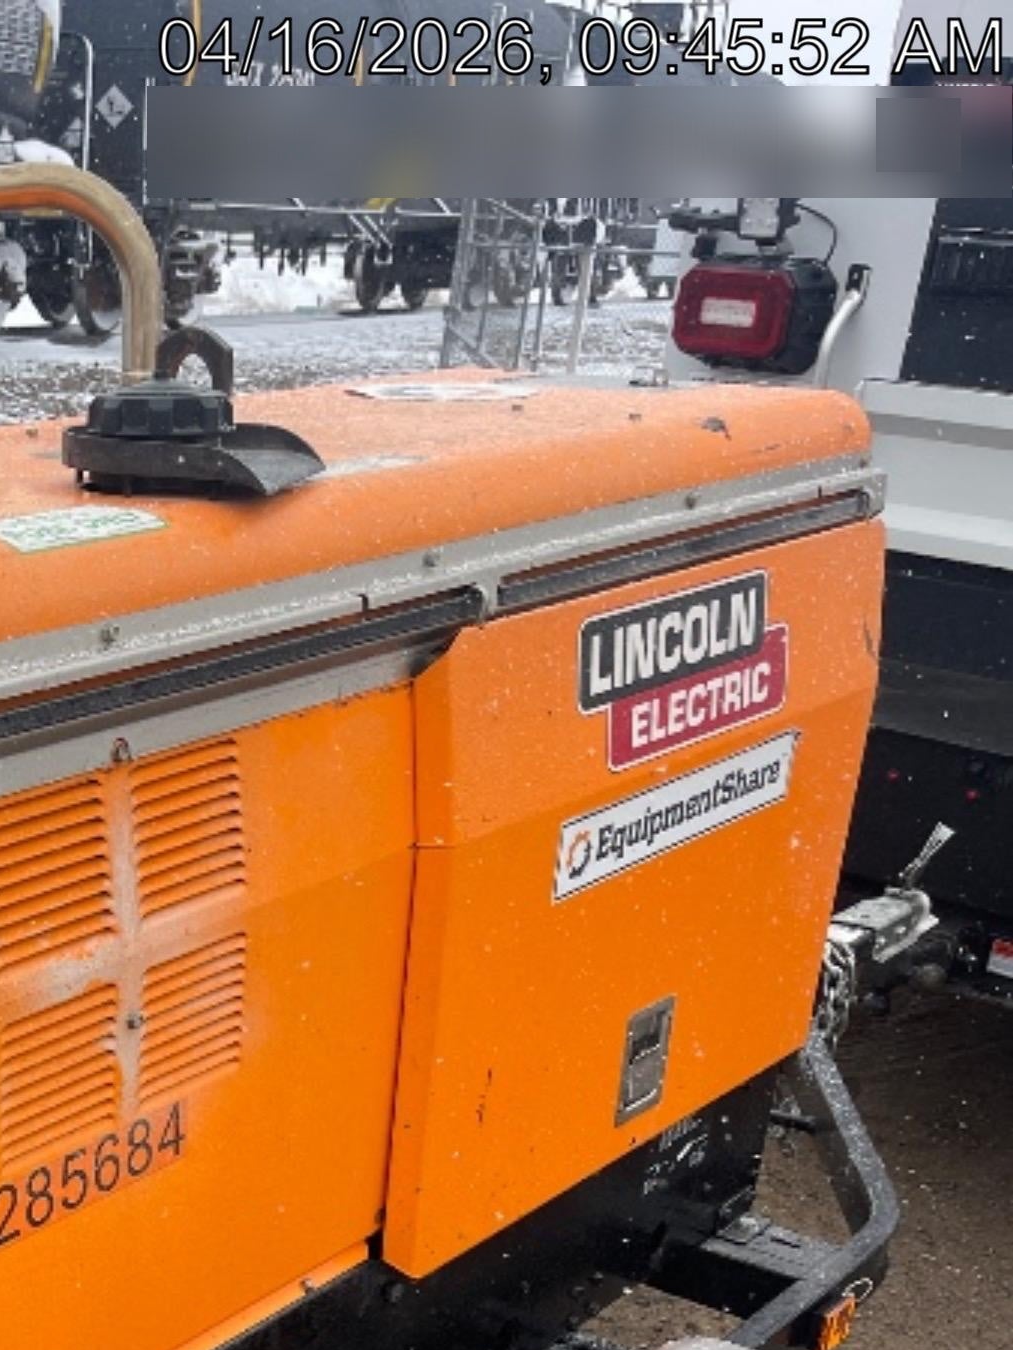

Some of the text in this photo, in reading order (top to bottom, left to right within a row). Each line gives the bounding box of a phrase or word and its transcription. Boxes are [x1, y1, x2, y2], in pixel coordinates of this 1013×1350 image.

[589, 586, 757, 697] LINCOLN
[630, 661, 771, 749] ELECTRIC
[596, 757, 781, 862] EquipmentShare
